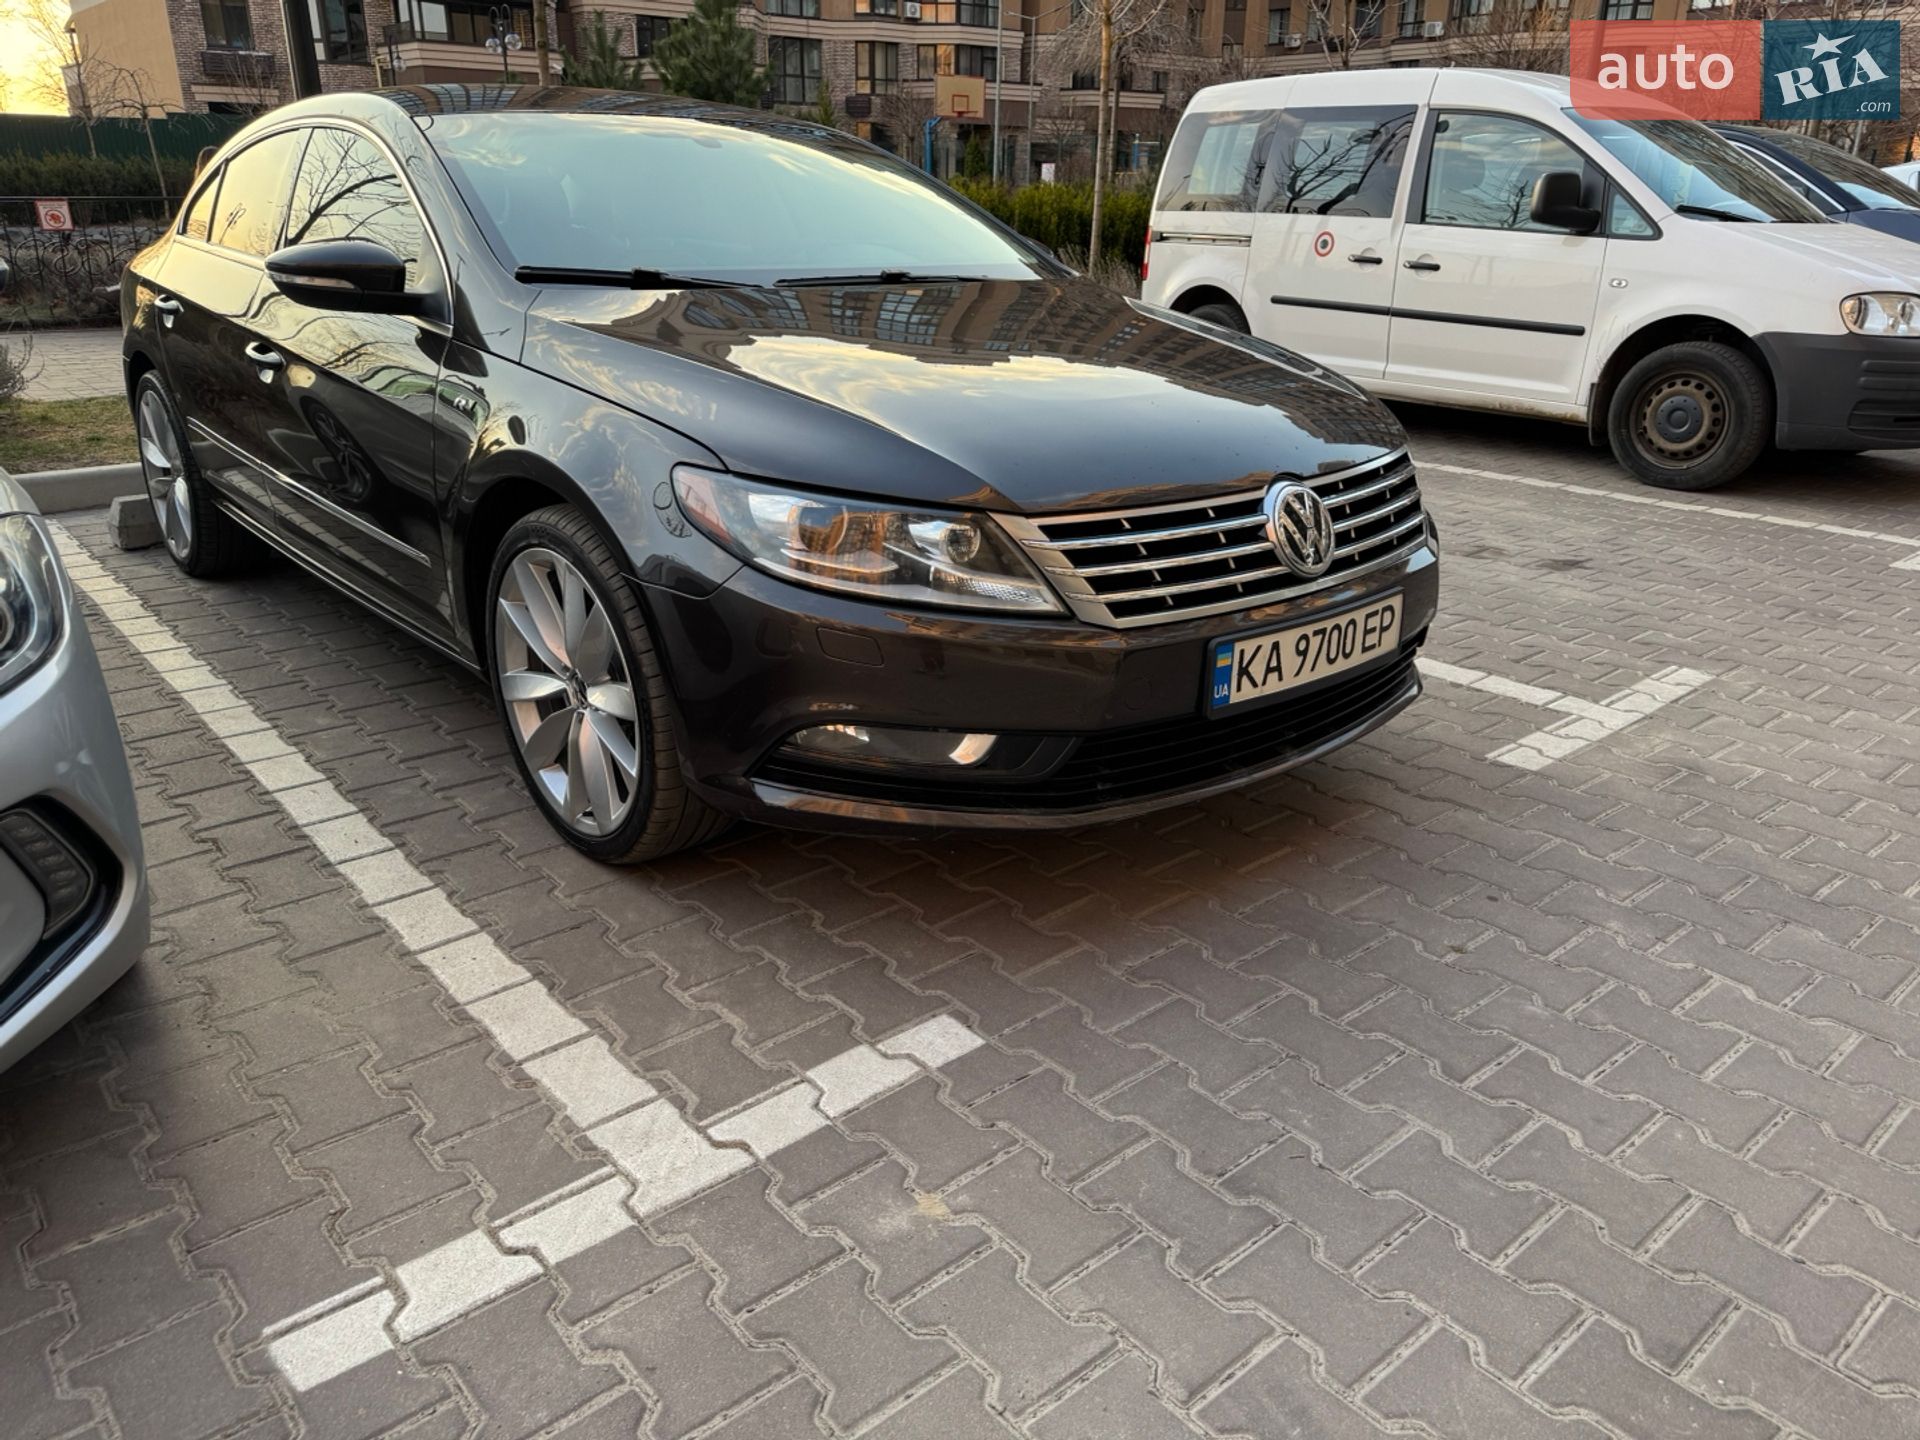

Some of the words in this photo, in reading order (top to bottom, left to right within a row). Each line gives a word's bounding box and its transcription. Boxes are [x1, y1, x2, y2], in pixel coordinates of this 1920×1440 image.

[1235, 640, 1284, 693] KA
[1293, 618, 1358, 678] 9700
[1361, 604, 1396, 654] EP
[1213, 683, 1230, 699] UA
